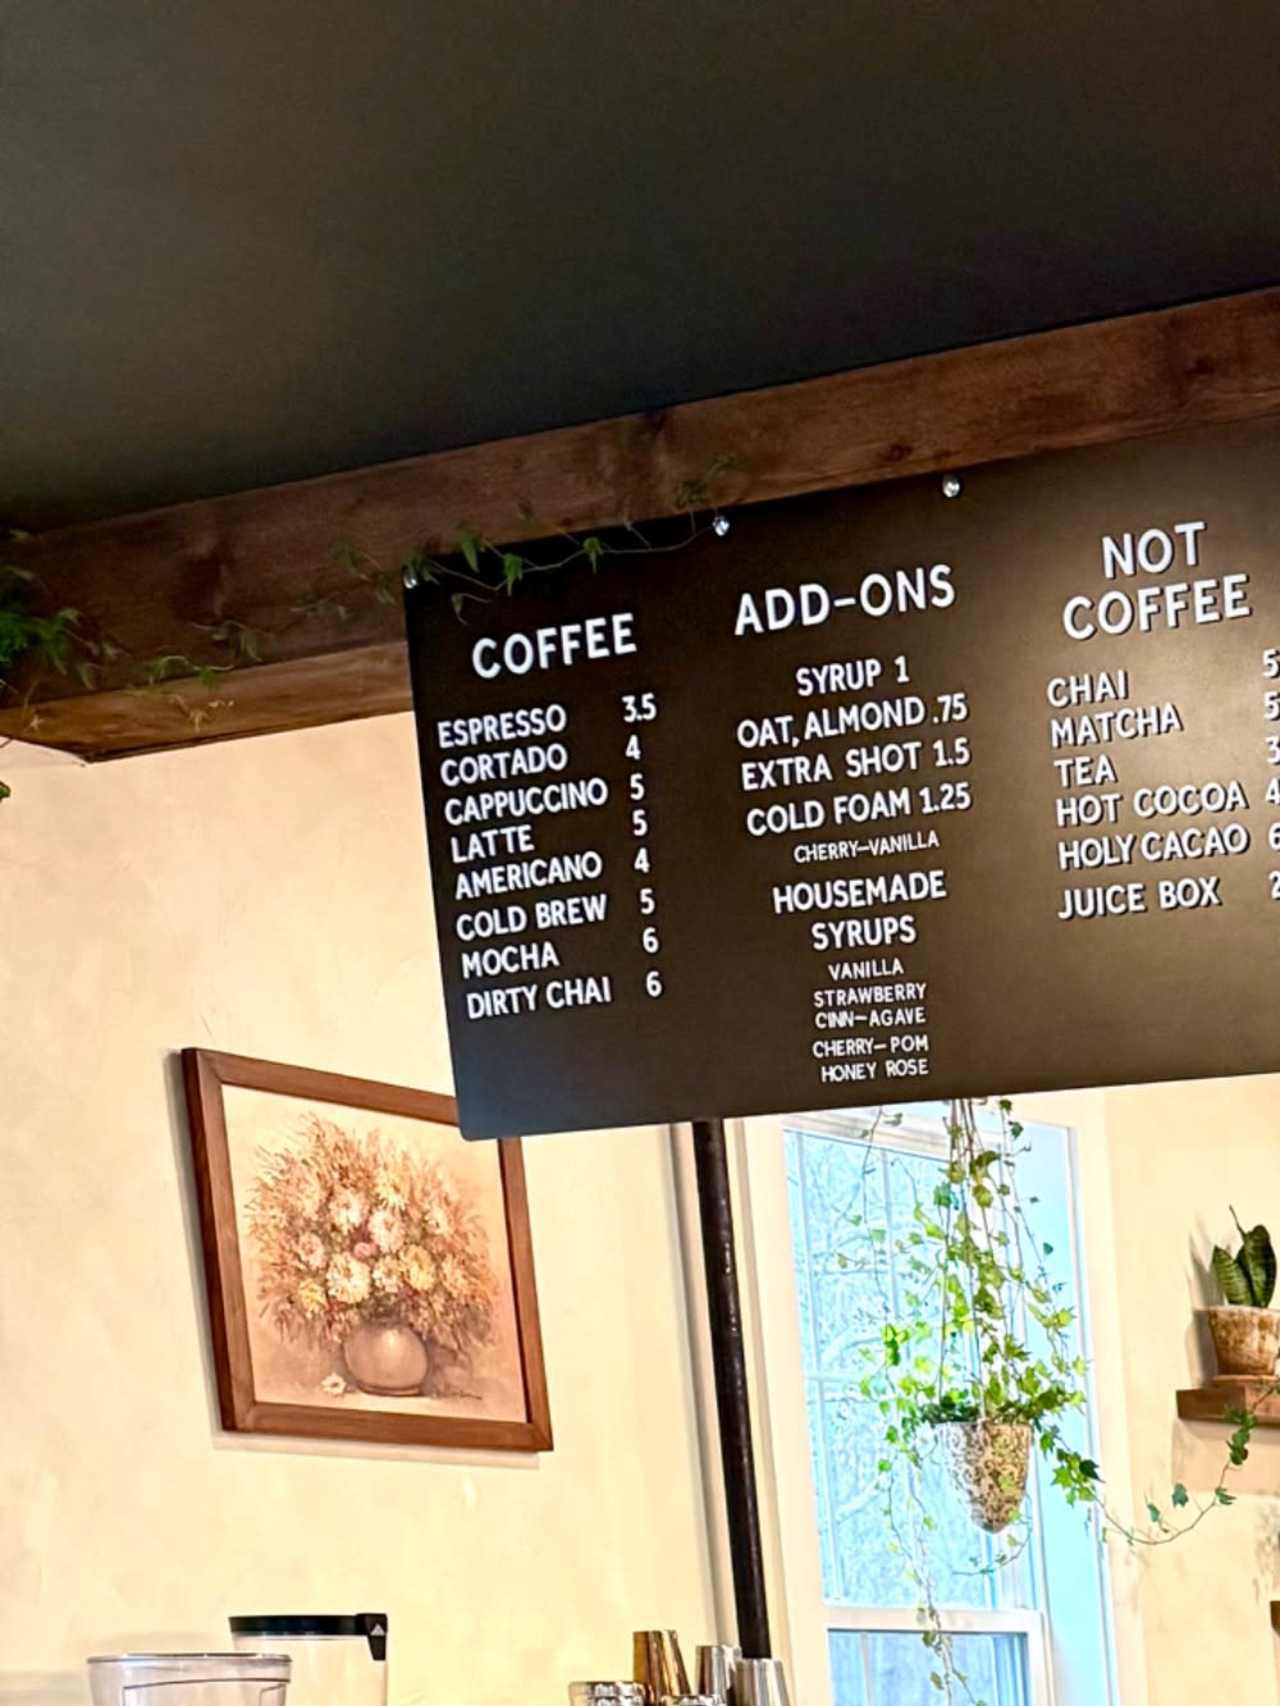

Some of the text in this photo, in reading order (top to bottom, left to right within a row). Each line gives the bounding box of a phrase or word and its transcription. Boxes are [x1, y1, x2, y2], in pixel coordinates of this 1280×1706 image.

[1102, 521, 1206, 579] NOT
[734, 564, 955, 635] ADD-ONS
[1062, 573, 1251, 640] COFFEE
[472, 612, 637, 678] COFFEE
[796, 656, 909, 696] SYRUP 1
[1047, 669, 1128, 708] CHAI
[437, 693, 657, 748] ESPRESSO 3.5
[737, 693, 967, 748] OAT, ALMOND .75
[1051, 702, 1183, 748] MATCHA
[440, 735, 640, 787] CORTADO 4
[741, 737, 970, 791] EXTRA SHOT 1.5
[1054, 754, 1117, 787] TEA
[444, 773, 645, 826] CAPPUCCINO 5
[747, 782, 971, 836] COLD FOAM 1.25
[1056, 793, 1122, 827] HOT
[1134, 780, 1249, 819] COCOA
[451, 809, 648, 863] LATTE 5
[1058, 833, 1136, 870] HOLY
[1141, 823, 1250, 862] CACAO
[456, 848, 650, 900] AMERICANO 4
[772, 870, 947, 914] HOUSEMADE
[1058, 883, 1146, 920] JUICE
[1159, 876, 1222, 910] BOX
[456, 888, 655, 941] COLD BREW 5
[811, 915, 917, 951] SYRUPS
[461, 927, 659, 979] MOCHA 6
[828, 957, 904, 981] VANILLA
[467, 971, 662, 1019] DIRTY CHAI 6
[813, 982, 927, 1008] STRAWBERRY
[821, 1058, 929, 1083] HONEY ROSE
